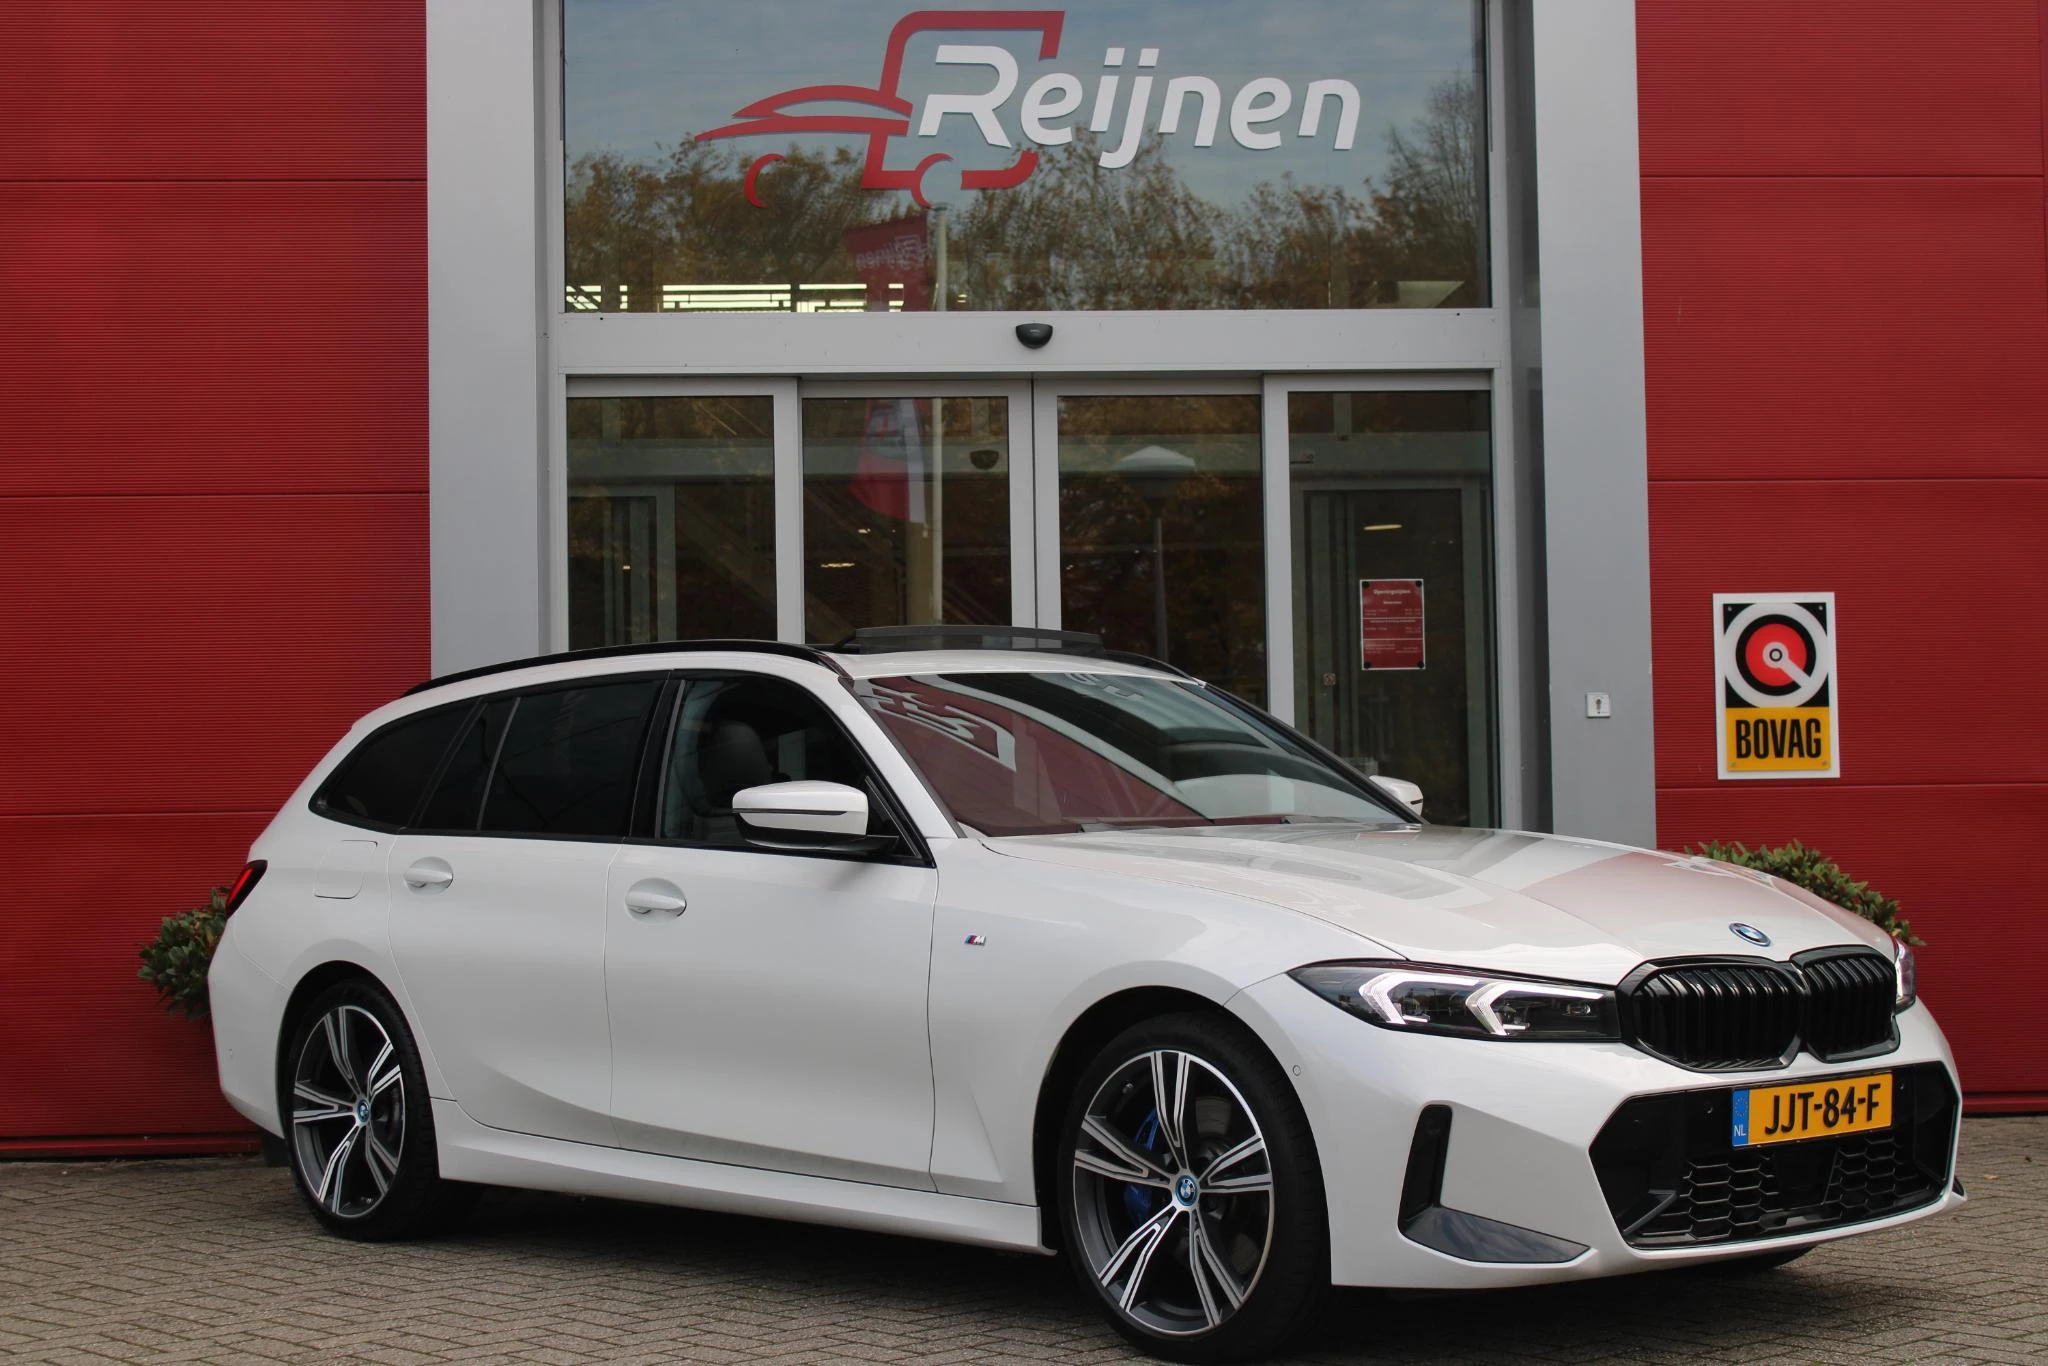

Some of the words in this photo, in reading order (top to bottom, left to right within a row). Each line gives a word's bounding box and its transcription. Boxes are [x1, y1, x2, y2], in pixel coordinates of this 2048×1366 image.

[918, 44, 1361, 169] Reijnen
[1735, 718, 1822, 760] BOVAG
[1733, 1124, 1747, 1137] NL
[1764, 1083, 1881, 1135] JJT-84-F
